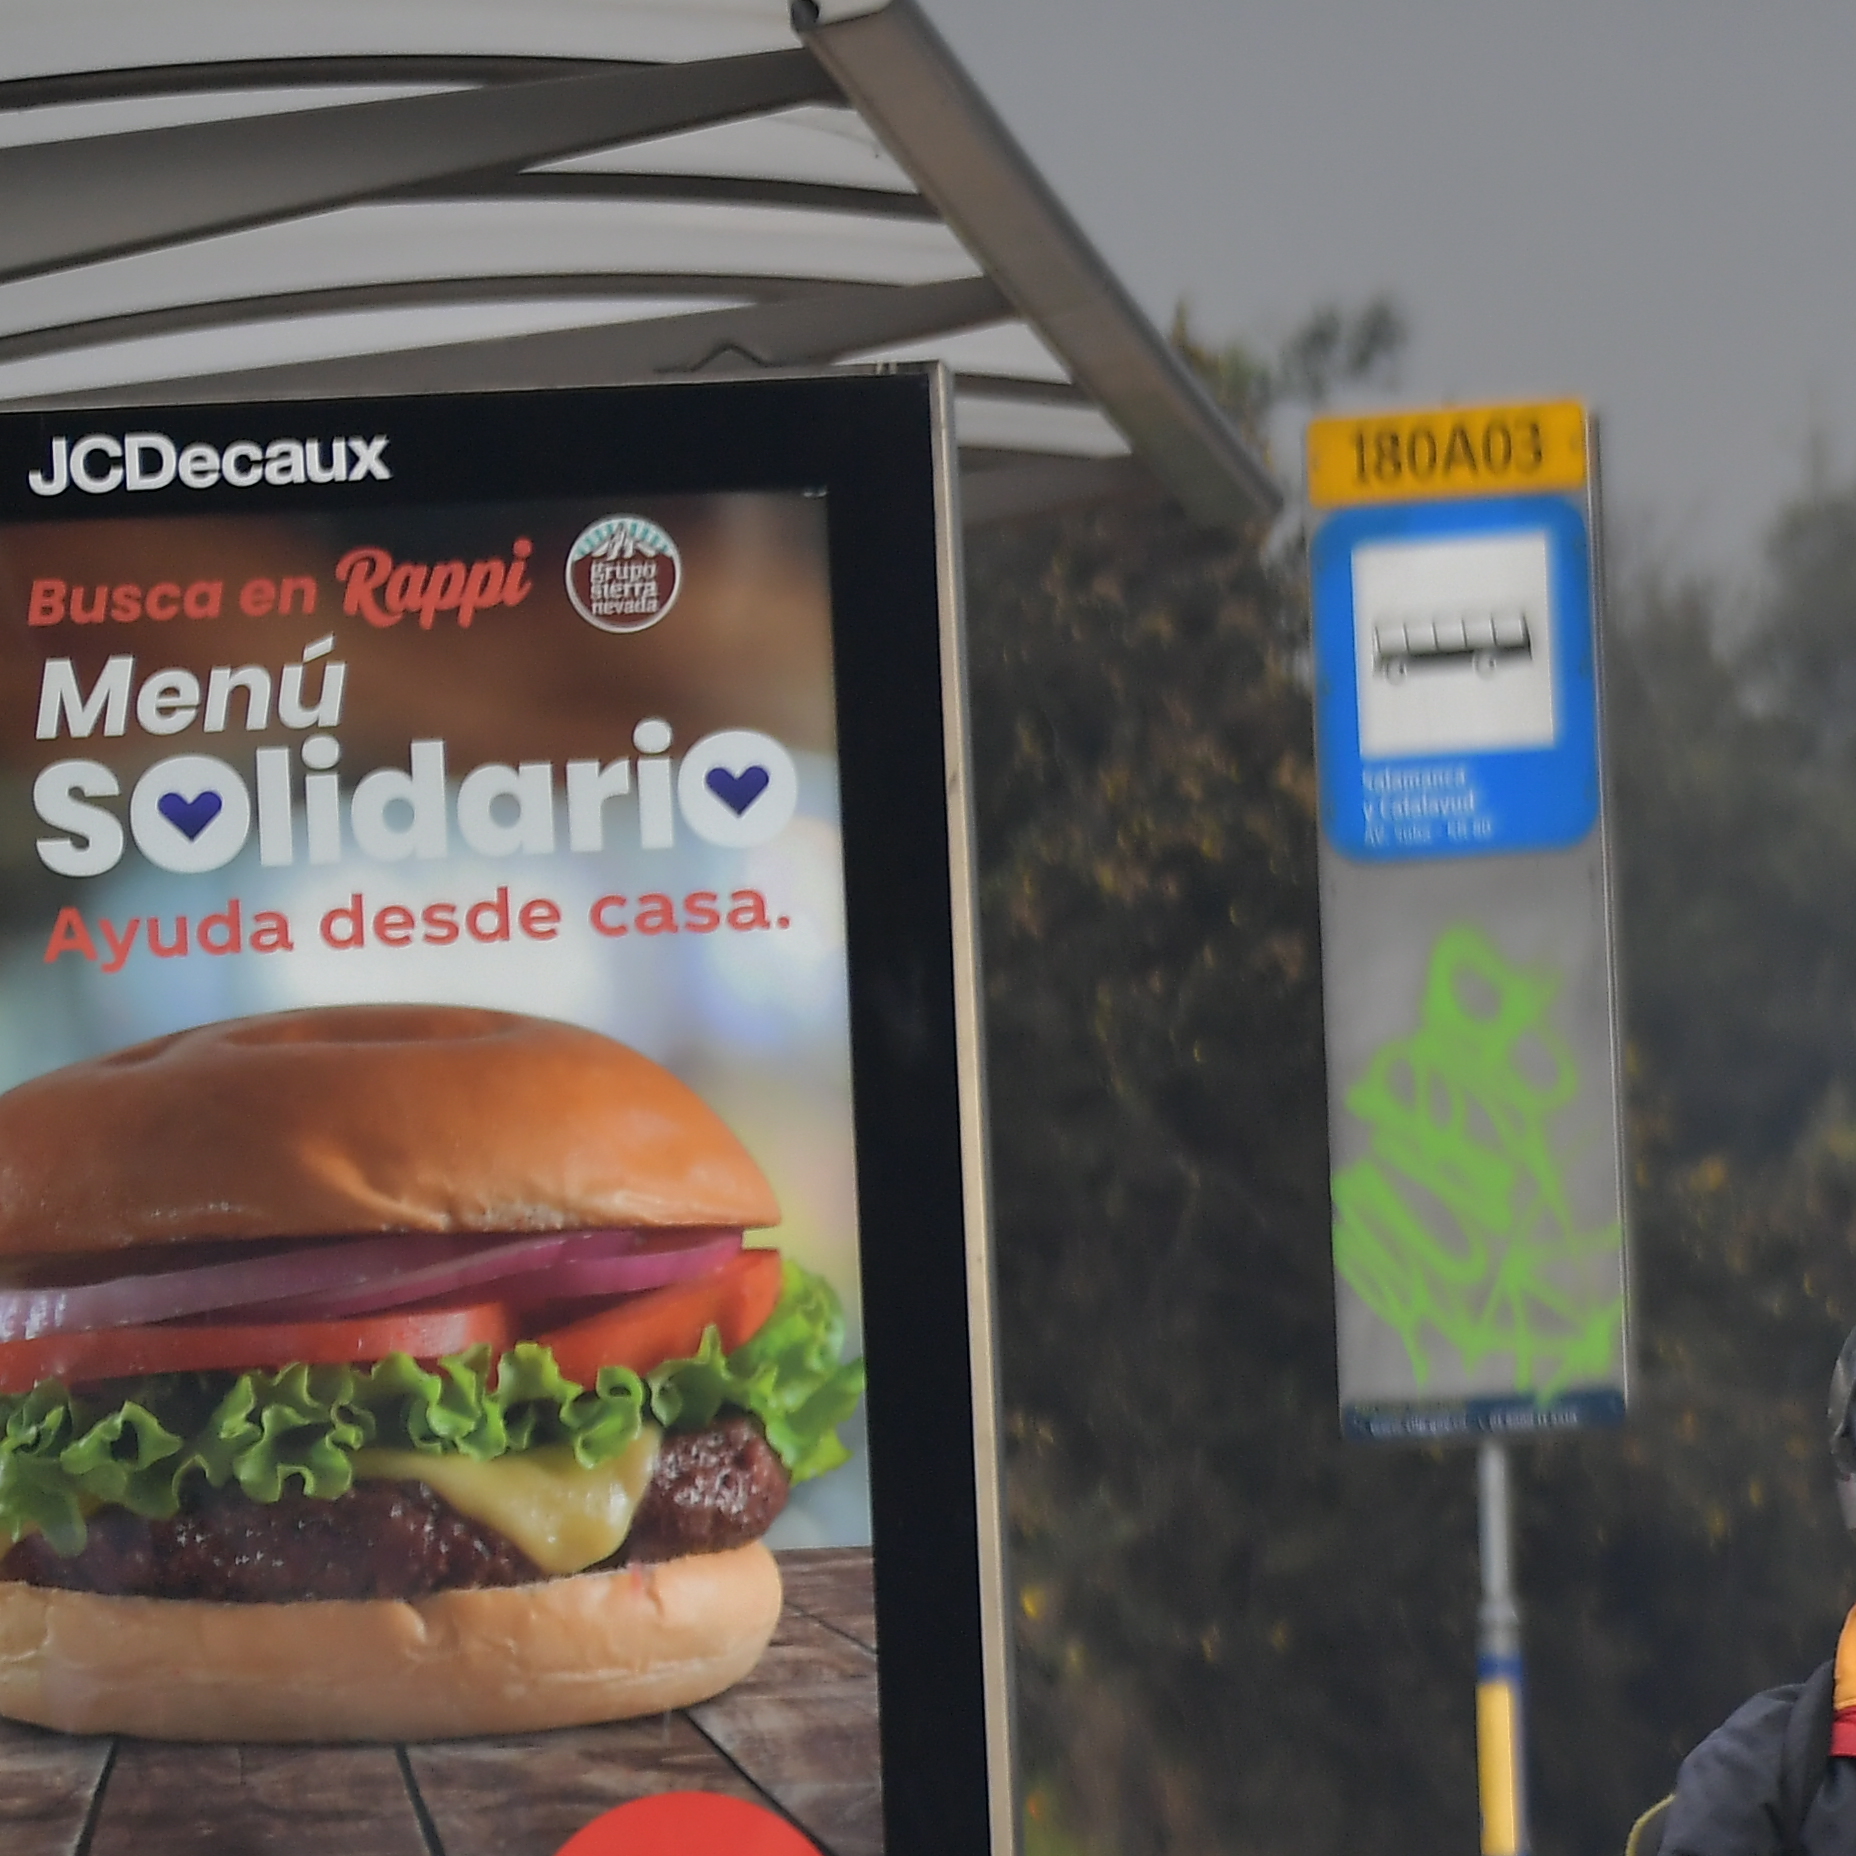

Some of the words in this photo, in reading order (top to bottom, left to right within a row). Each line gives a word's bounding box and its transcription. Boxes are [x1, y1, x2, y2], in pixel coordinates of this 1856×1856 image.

[28, 433, 391, 497] JCDecaux
[1352, 418, 1544, 485] 180A03
[27, 574, 221, 627] Busca
[240, 575, 317, 616] en
[335, 537, 534, 630] Rappi
[35, 633, 349, 741] Menú
[43, 898, 293, 974] Ayuda
[319, 887, 562, 950] desde
[588, 888, 793, 939] casa.
